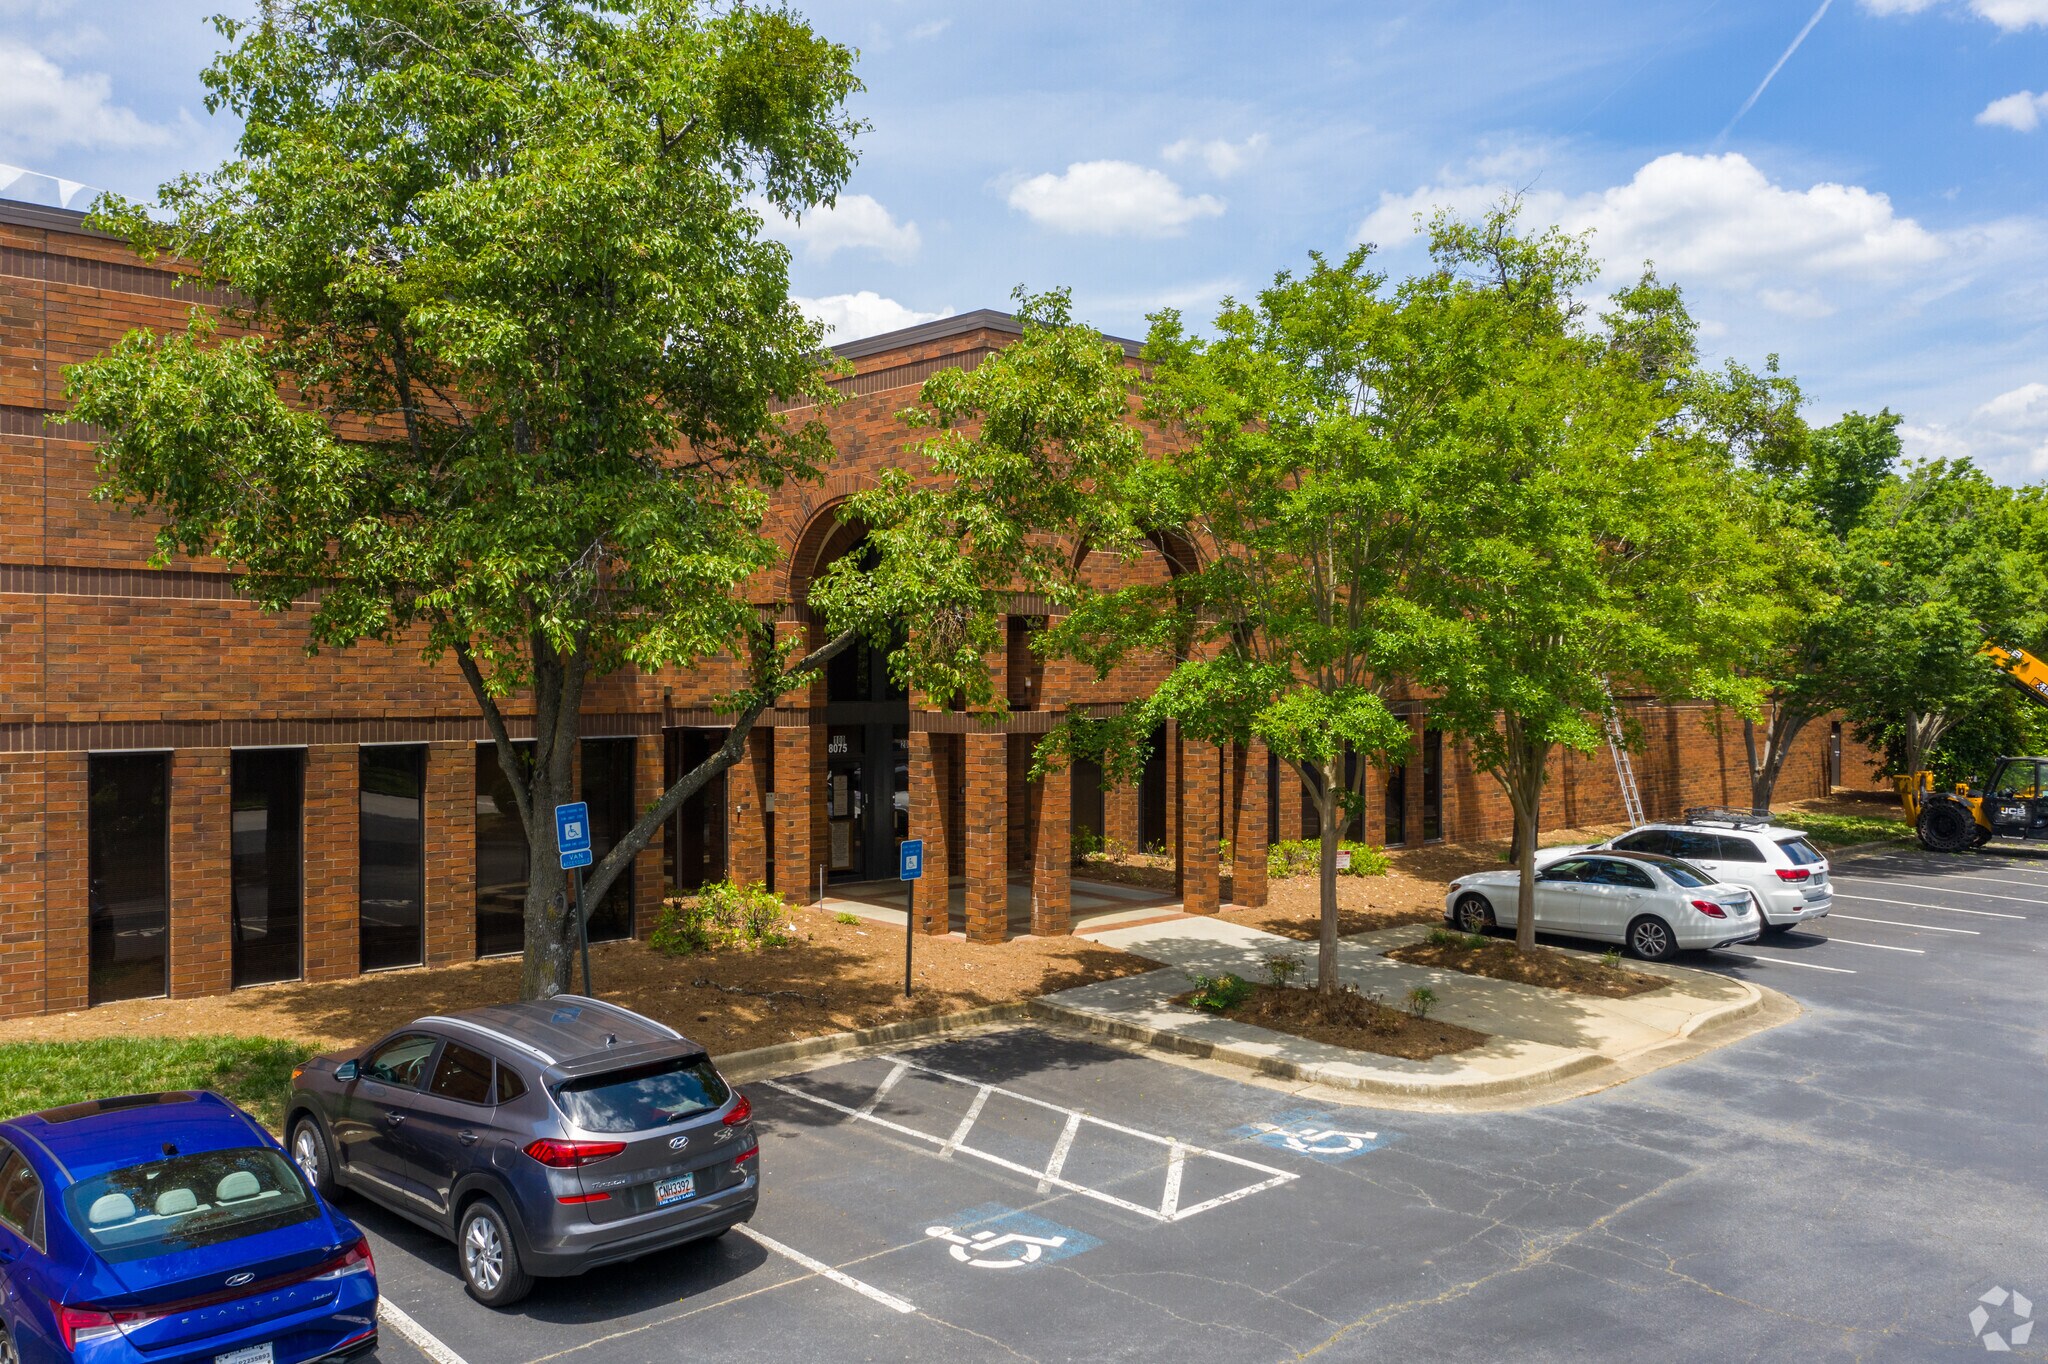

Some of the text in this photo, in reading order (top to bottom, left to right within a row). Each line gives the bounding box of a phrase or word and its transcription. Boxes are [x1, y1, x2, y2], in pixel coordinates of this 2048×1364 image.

[828, 743, 848, 753] 8075
[2000, 806, 2026, 815] JCB
[658, 1179, 691, 1198] CNH3392
[181, 1291, 296, 1324] ELANTRA
